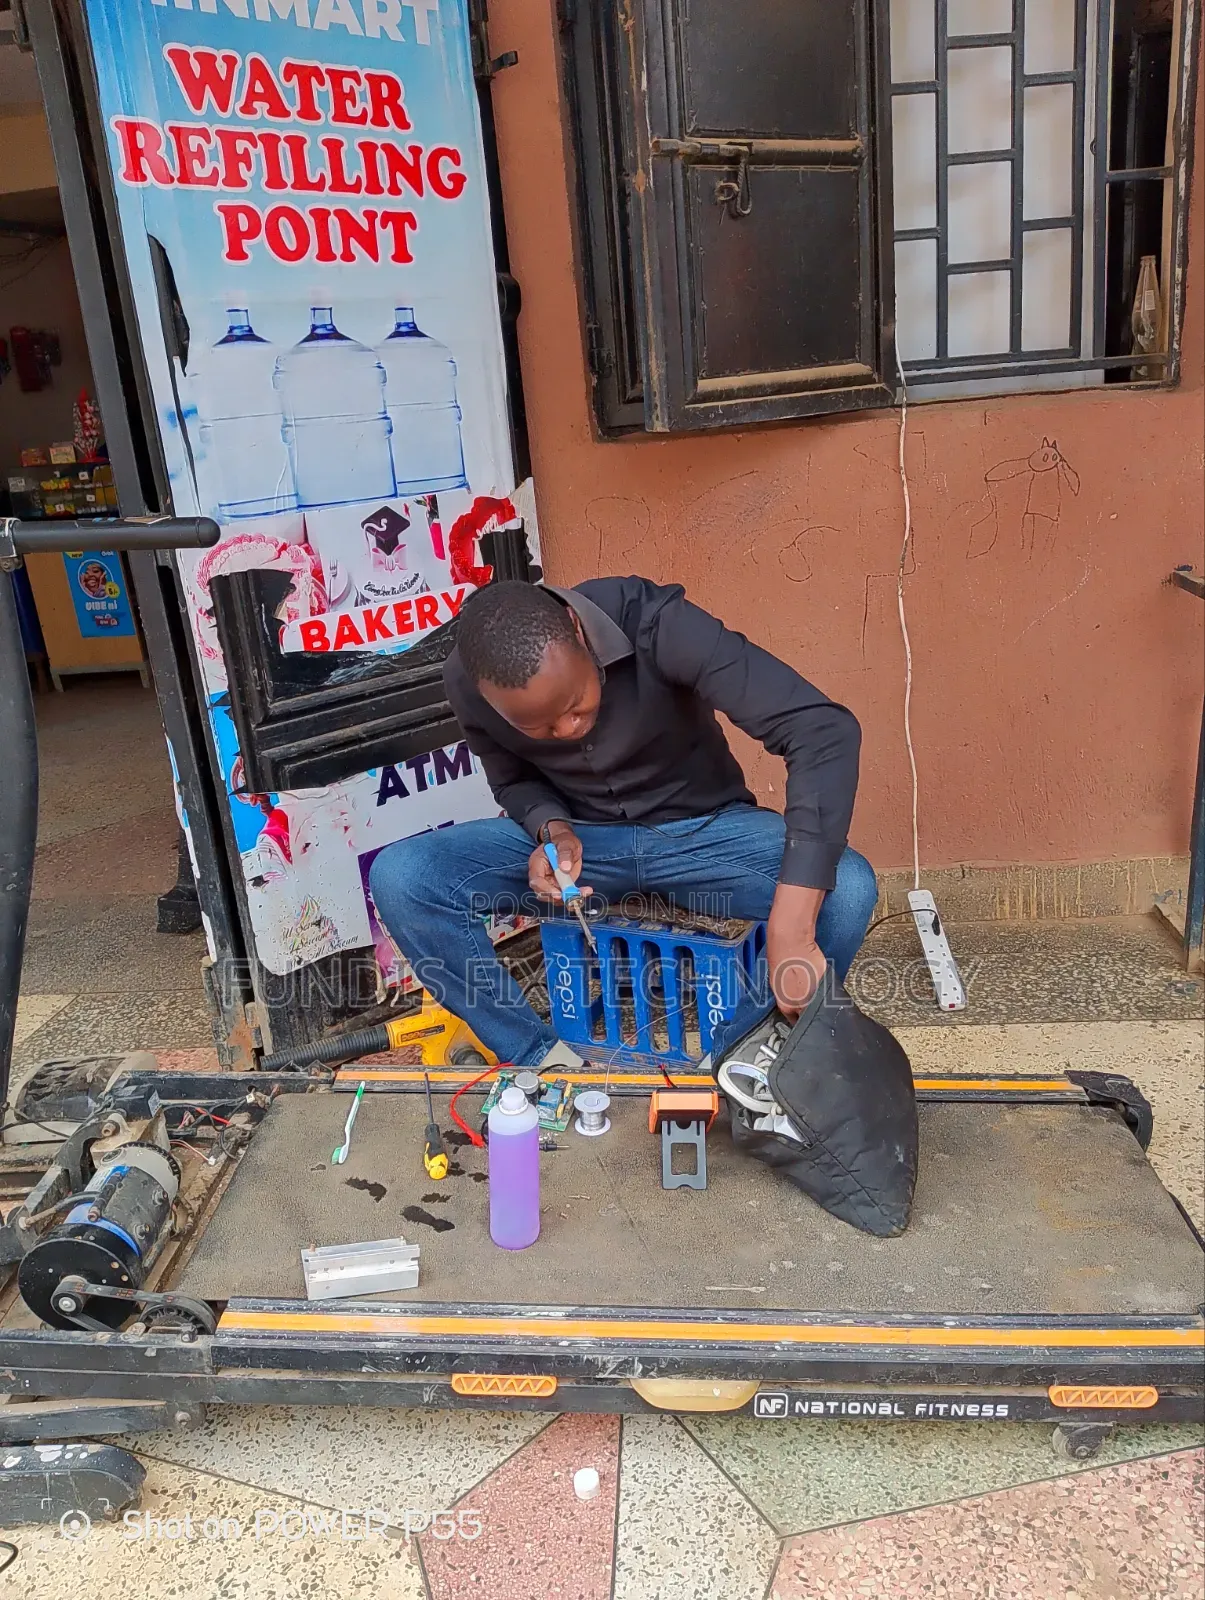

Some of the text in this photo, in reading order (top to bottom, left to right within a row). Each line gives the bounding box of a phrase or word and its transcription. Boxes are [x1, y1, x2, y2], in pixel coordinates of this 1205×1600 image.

[165, 45, 412, 131] WATER
[112, 118, 467, 200] REFILLING
[217, 203, 417, 263] POINT
[299, 588, 466, 653] BAKERY
[377, 742, 472, 807] ATM
[551, 951, 579, 1020] pepsi
[758, 1397, 786, 1415] NF
